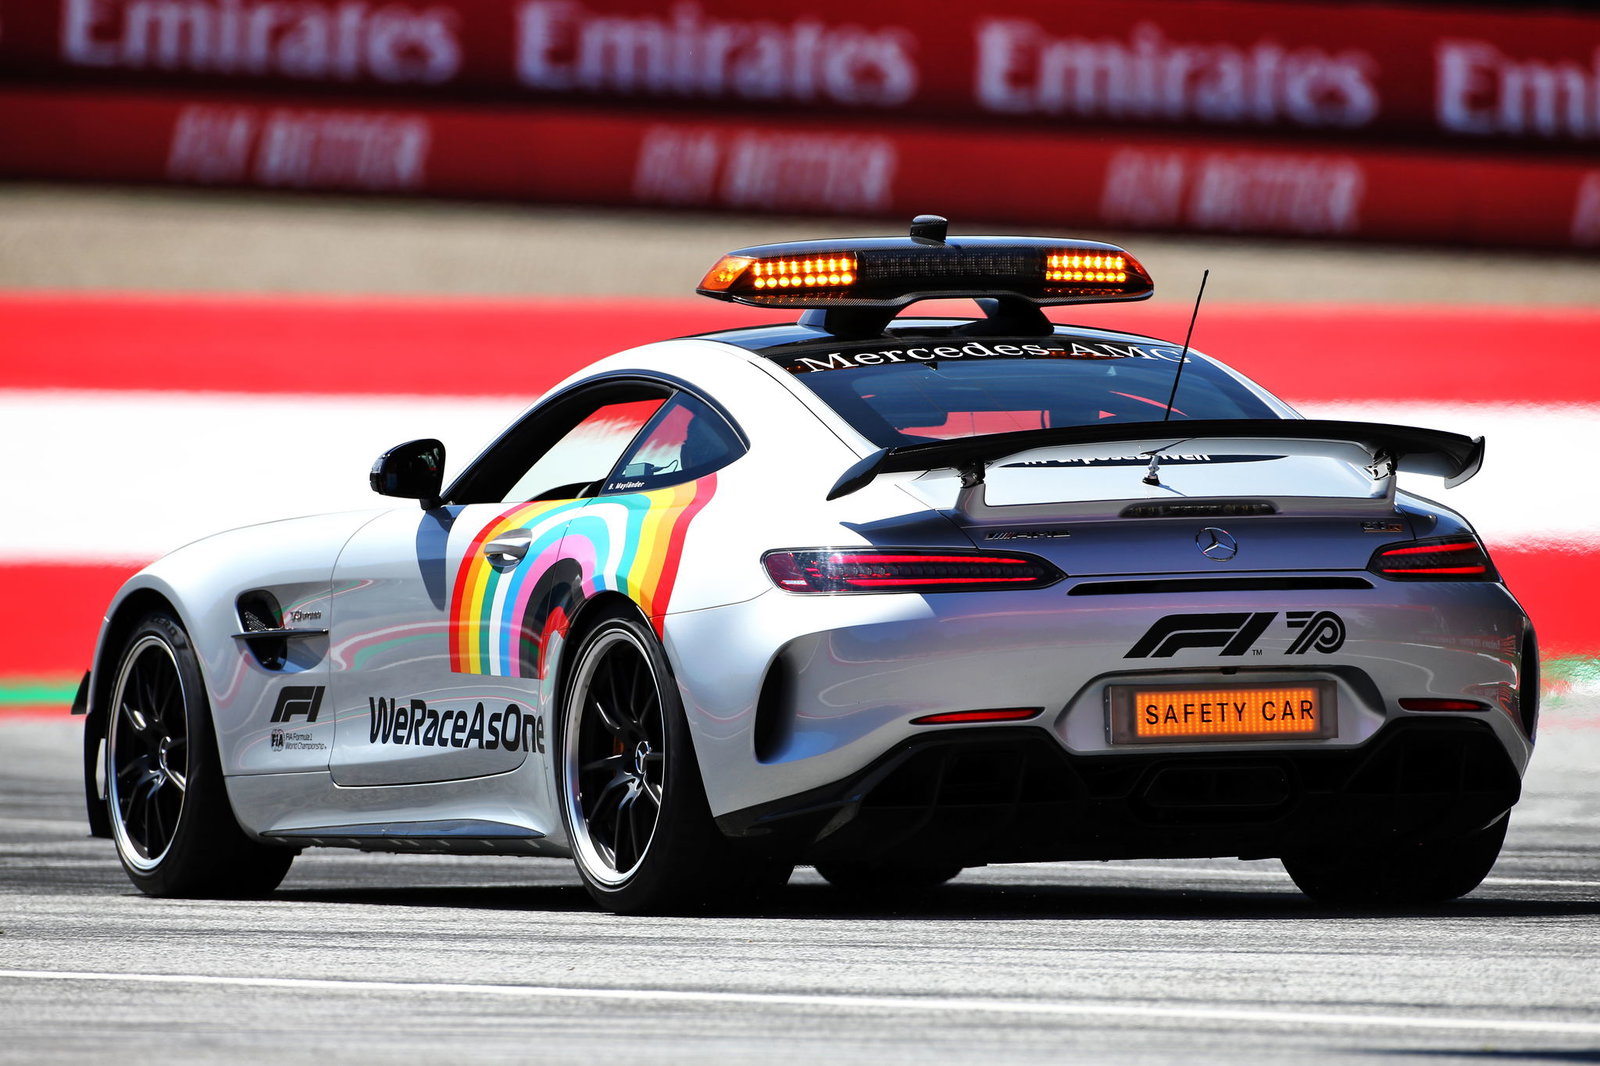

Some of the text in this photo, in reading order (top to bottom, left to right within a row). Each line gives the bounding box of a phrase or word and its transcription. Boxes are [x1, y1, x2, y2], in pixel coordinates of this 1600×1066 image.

[62, 0, 461, 84] Emirates
[516, 0, 915, 101] Emirates
[975, 18, 1378, 127] Emirates
[1436, 38, 1600, 136] Em
[795, 342, 1192, 374] Mercedes-AMG
[368, 696, 546, 754] WeRaceAsOne
[1145, 699, 1315, 725] SAFETY CAR
